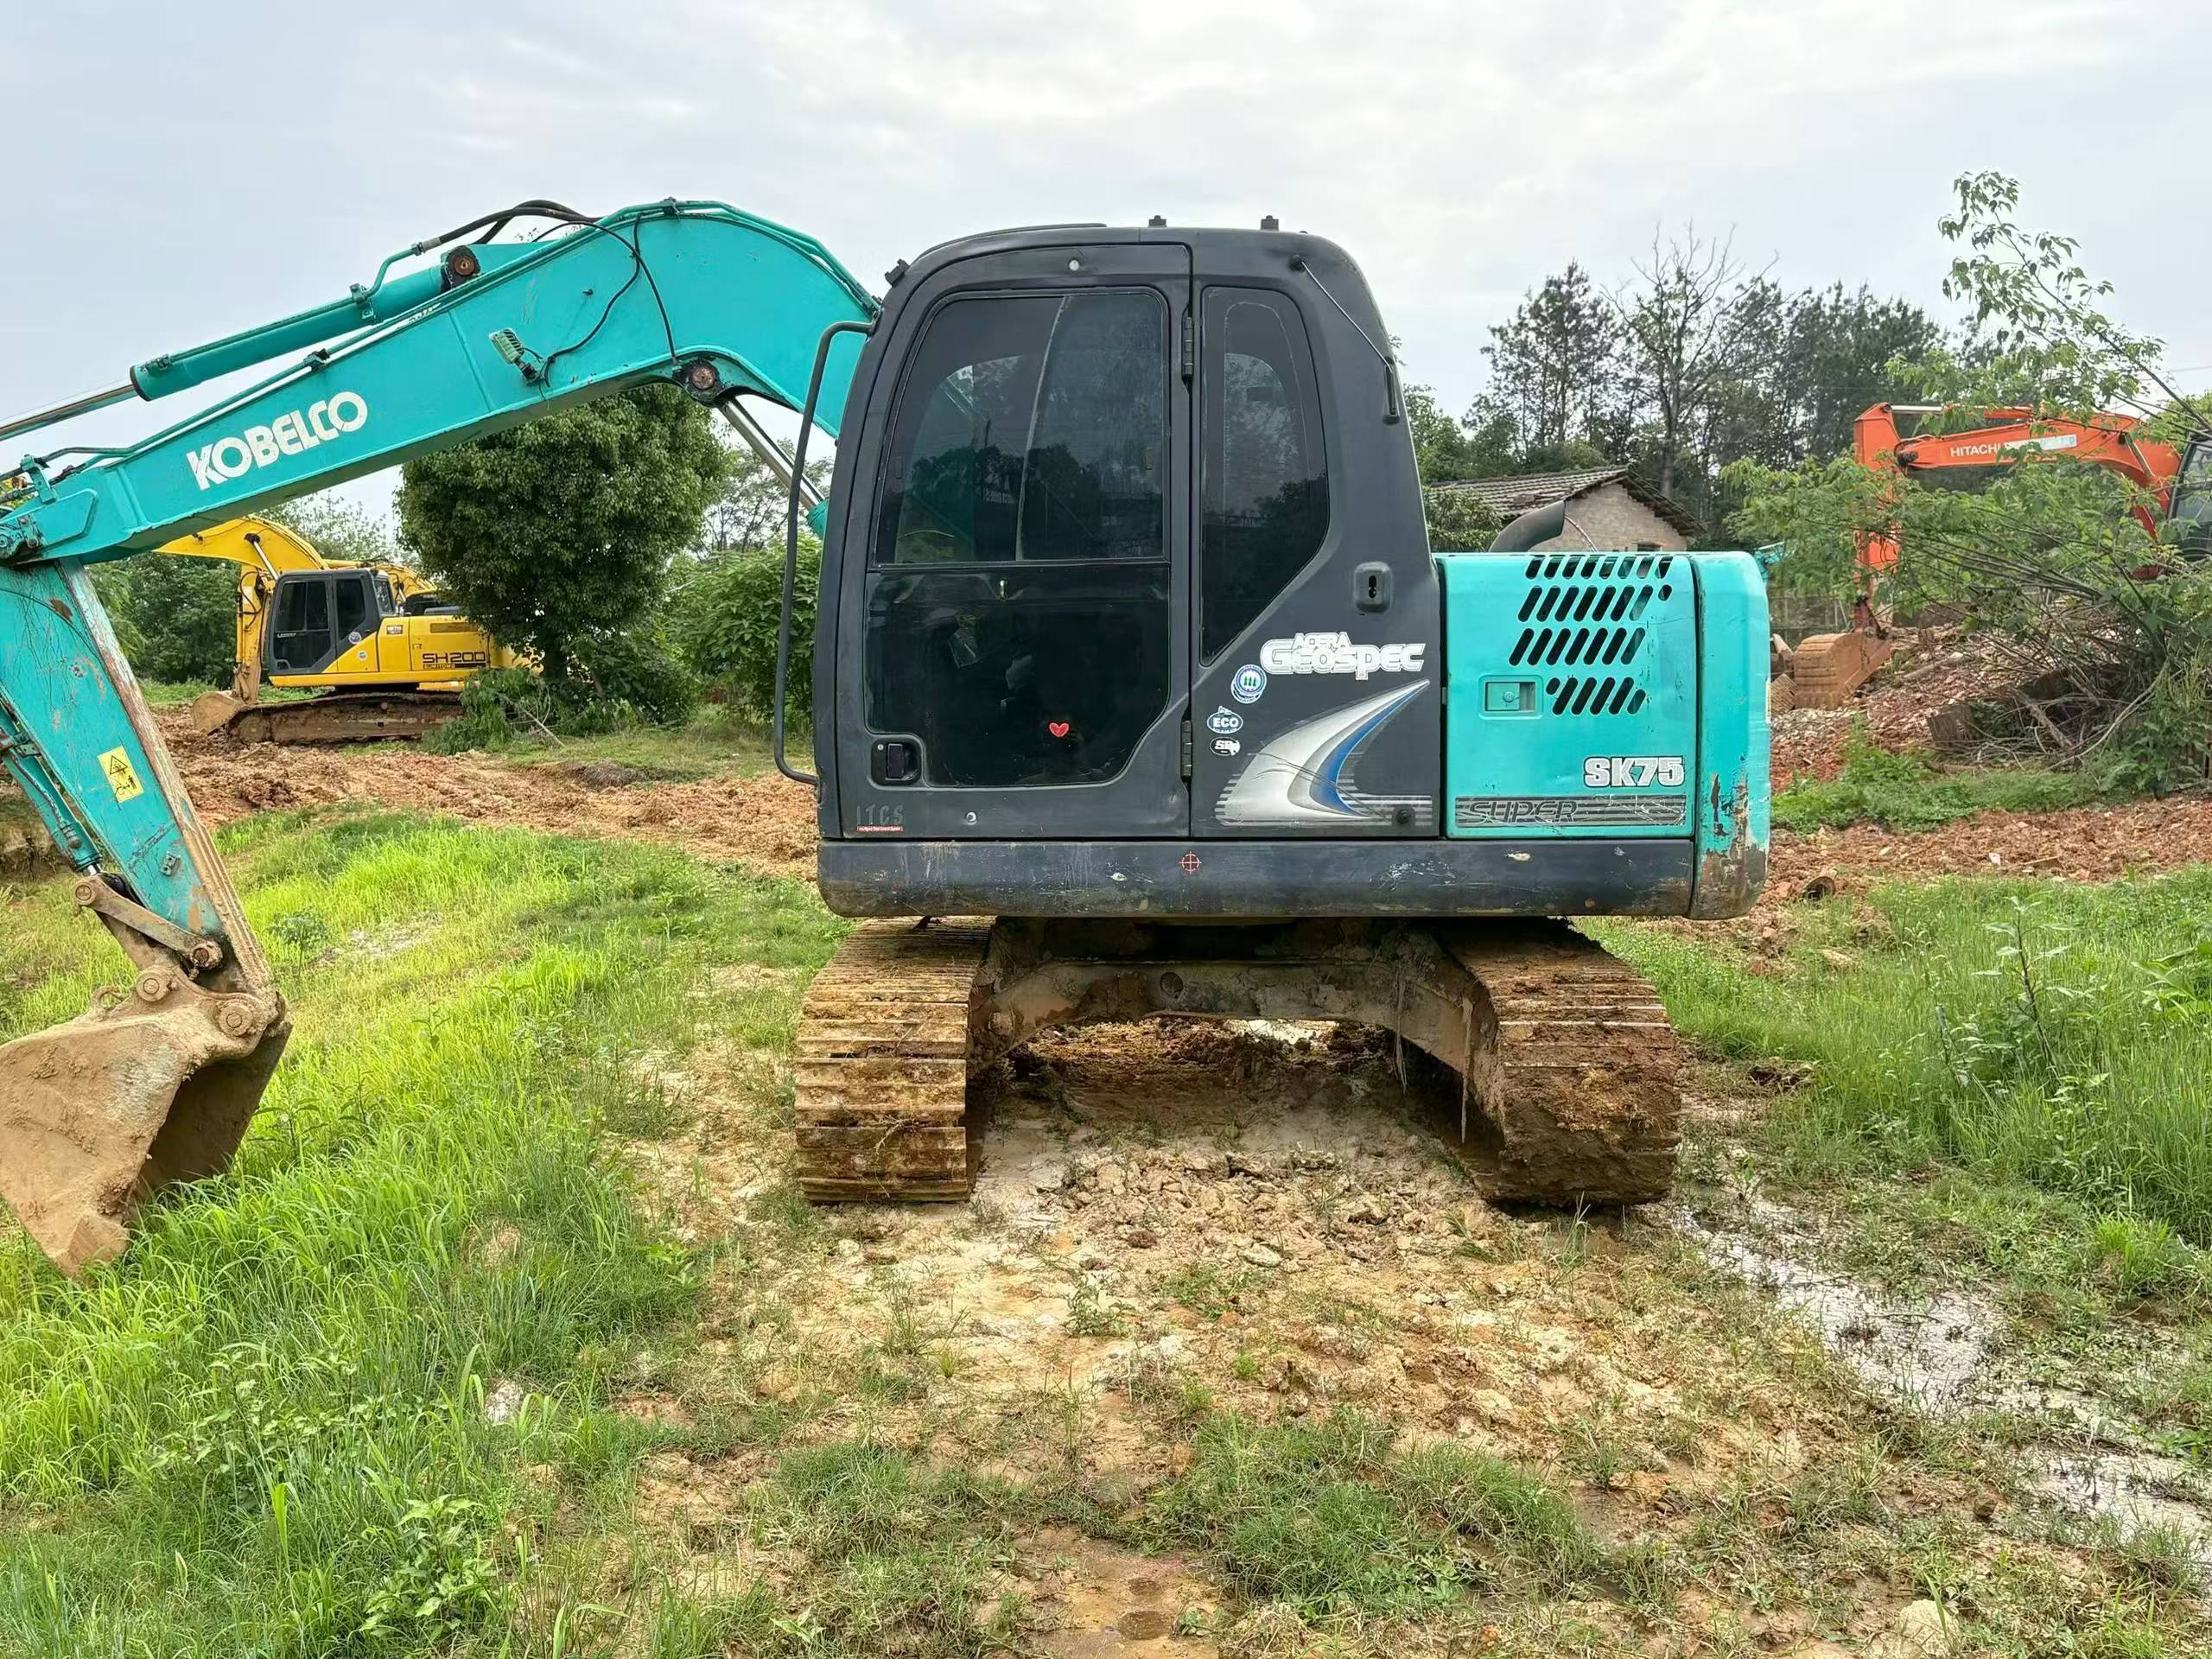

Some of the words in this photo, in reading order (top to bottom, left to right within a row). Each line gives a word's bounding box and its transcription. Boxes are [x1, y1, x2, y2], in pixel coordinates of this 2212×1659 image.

[186, 391, 368, 491] KOBELCO
[1212, 717, 1239, 728] ECO
[1583, 756, 1686, 788] SK75
